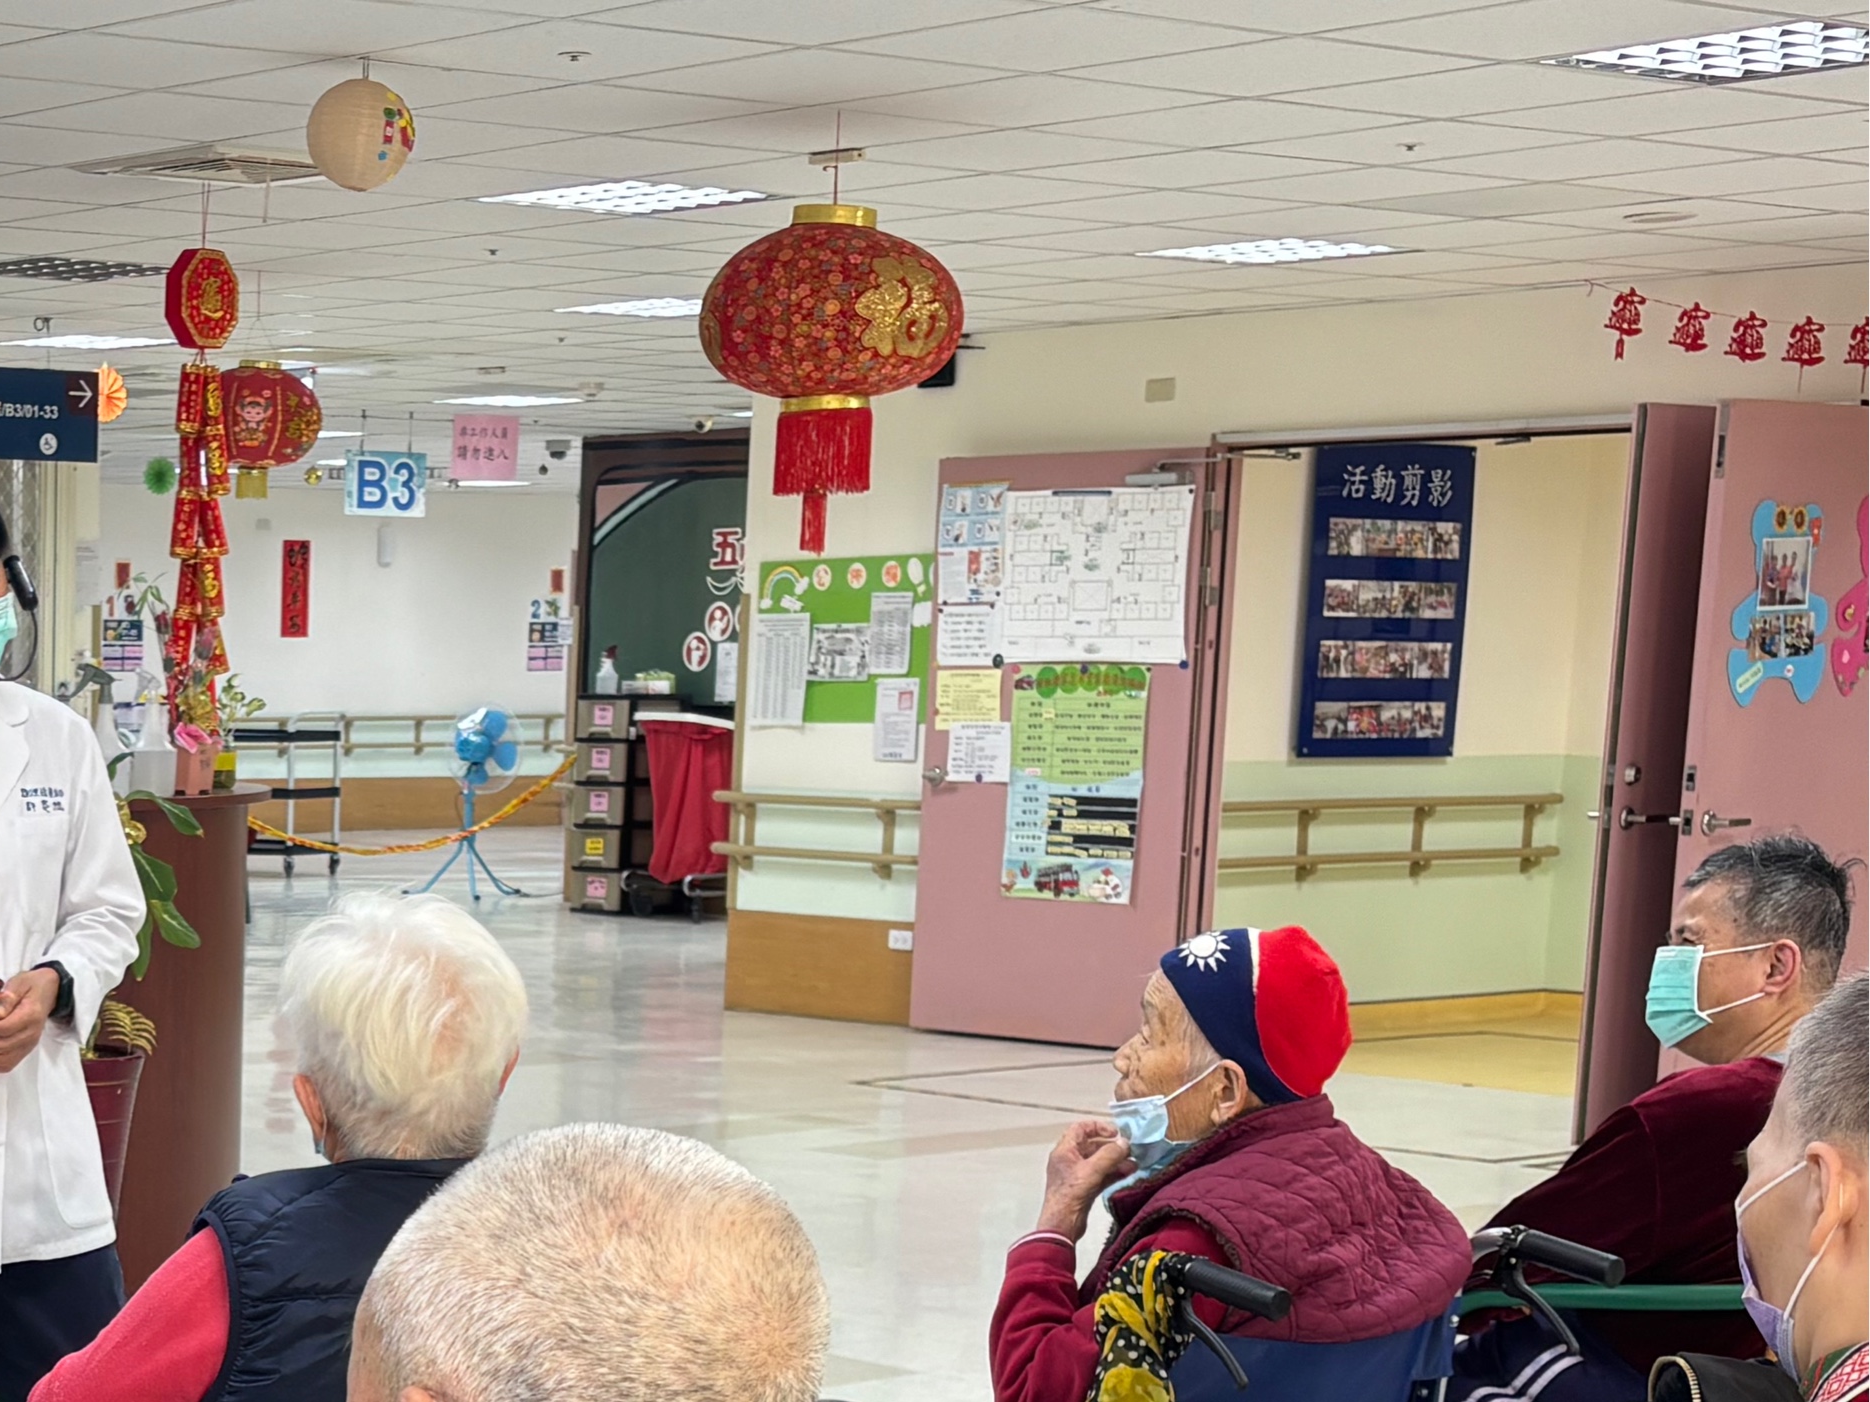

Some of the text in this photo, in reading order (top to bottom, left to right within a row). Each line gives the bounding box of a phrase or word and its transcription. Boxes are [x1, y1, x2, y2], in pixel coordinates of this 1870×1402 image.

[356, 459, 418, 512] B3
[1342, 464, 1453, 507] 活動剪影
